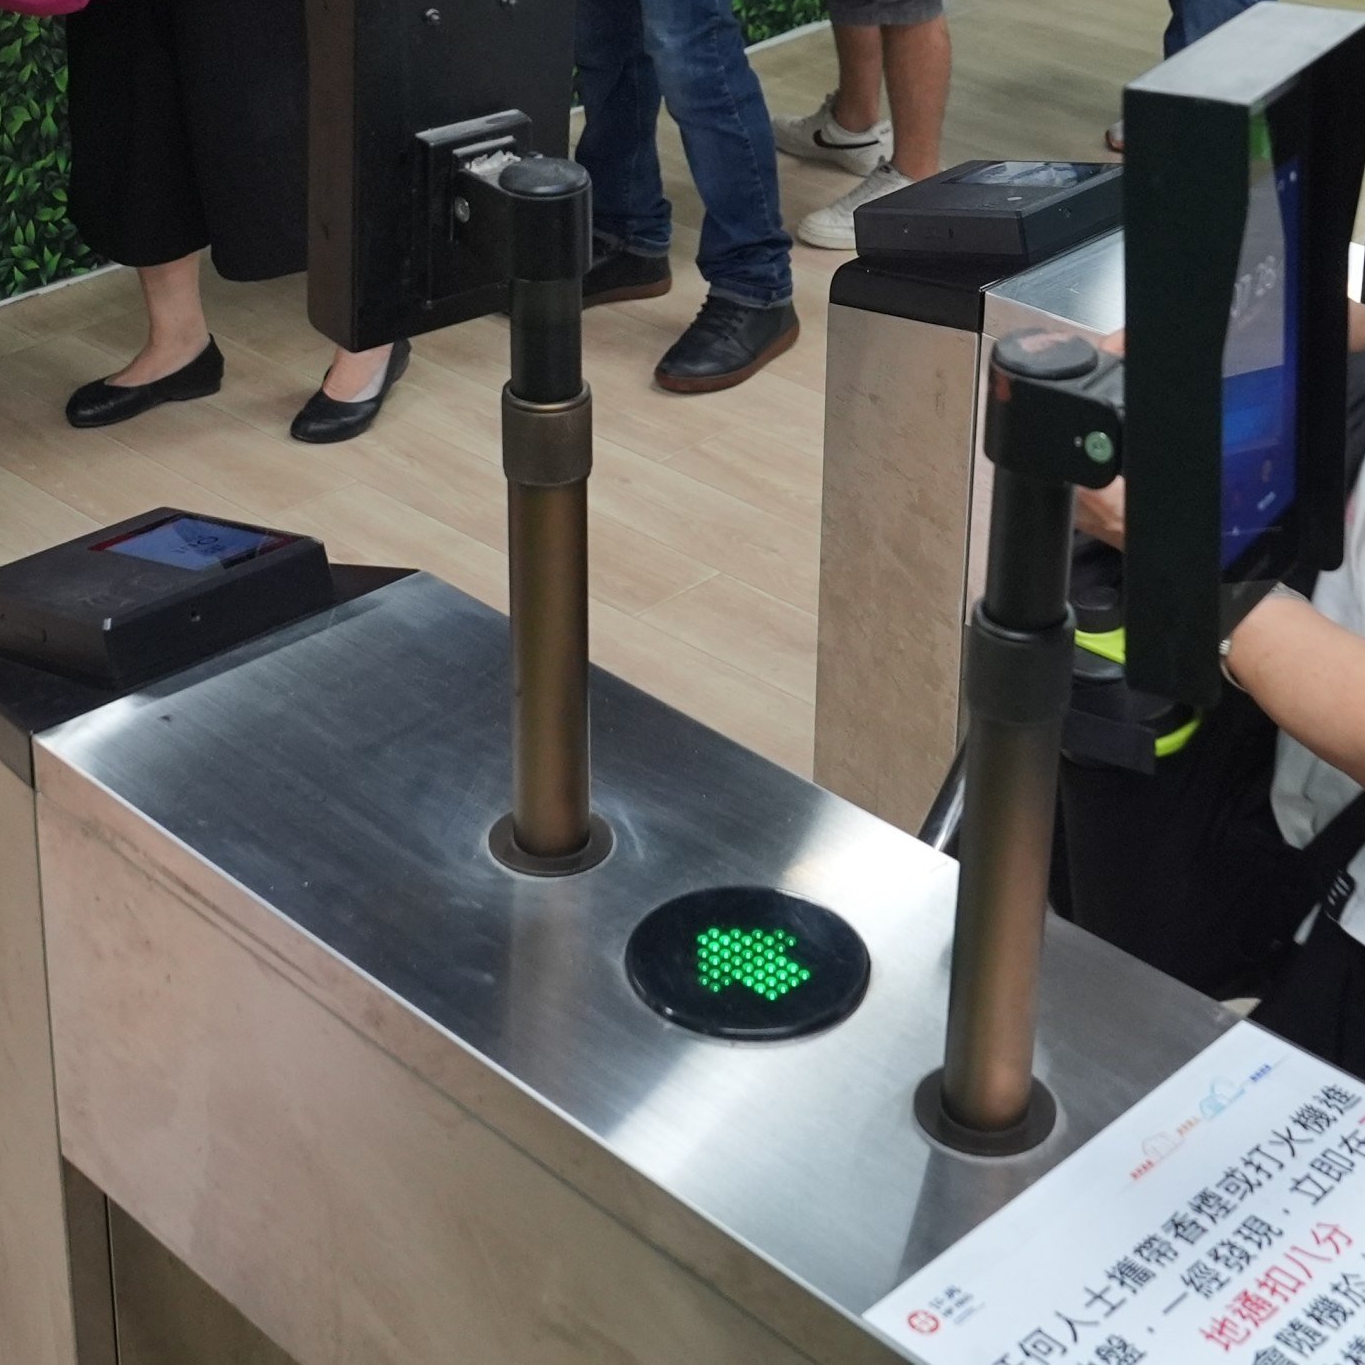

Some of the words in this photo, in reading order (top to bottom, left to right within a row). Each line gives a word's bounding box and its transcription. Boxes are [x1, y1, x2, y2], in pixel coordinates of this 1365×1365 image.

[1198, 1220, 1354, 1352] 地通扣八分
